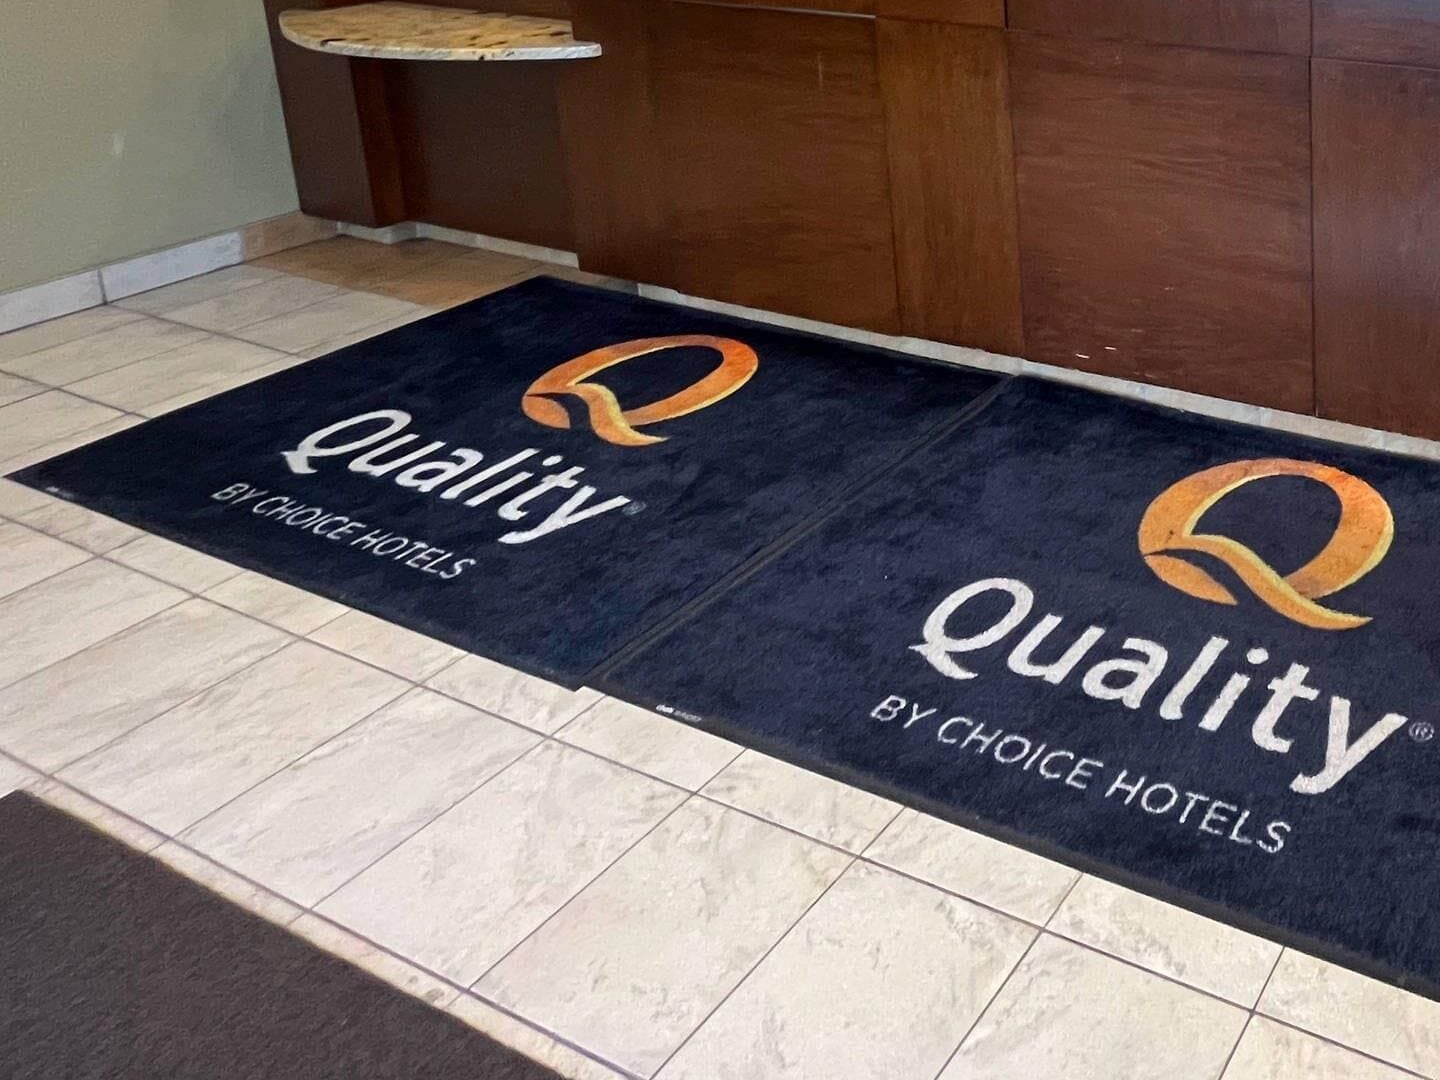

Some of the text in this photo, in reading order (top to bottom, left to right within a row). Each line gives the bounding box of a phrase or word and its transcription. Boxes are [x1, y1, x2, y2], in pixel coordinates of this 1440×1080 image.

[211, 483, 476, 580] BY CHOICE HOTELS
[870, 694, 1292, 854] BY CHOICE HOTELS
